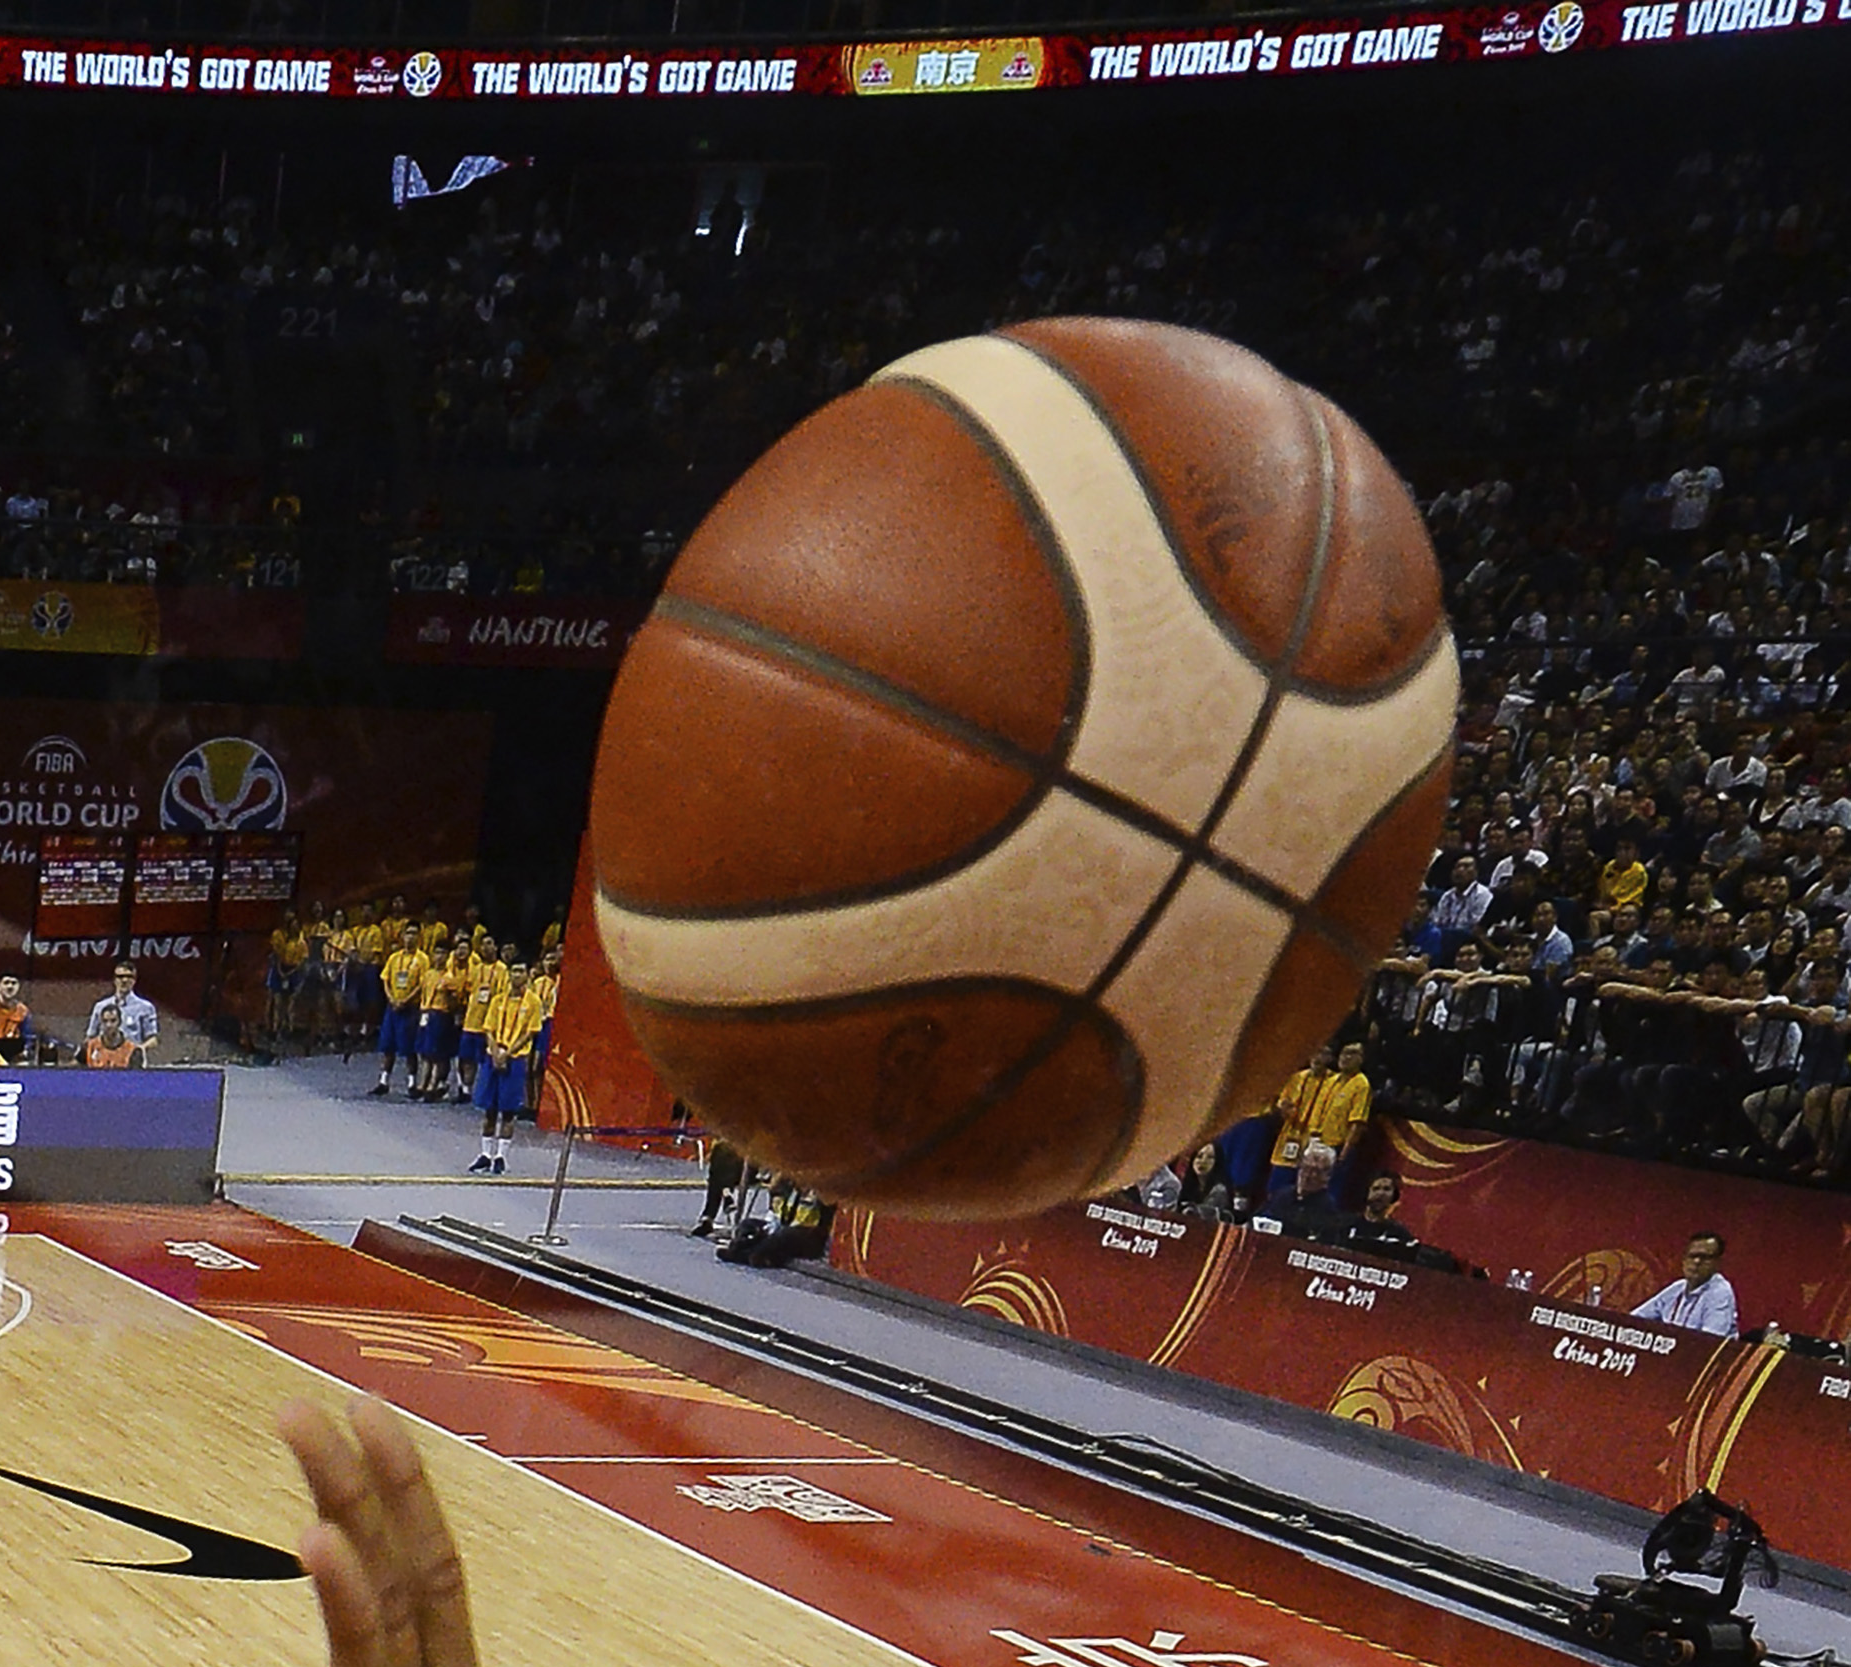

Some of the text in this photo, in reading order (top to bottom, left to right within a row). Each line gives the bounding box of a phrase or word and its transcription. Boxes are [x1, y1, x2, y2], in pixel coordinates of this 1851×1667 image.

[1623, 3, 1674, 41] THE
[915, 52, 976, 86] 南京
[1089, 24, 1443, 80] THE WORLD'S GOT GAME
[22, 49, 332, 92] THE WORLD'S GOT GAME
[472, 55, 797, 95] THE WORLD'S GOT GAME
[259, 558, 301, 588] 121
[406, 564, 448, 591] 122
[34, 751, 75, 775] FIBA
[79, 802, 141, 830] CUP
[1305, 1276, 1377, 1311] China 2019
[1530, 1305, 1677, 1355] FIBA BASKETBALL WORLD CUP
[1552, 1336, 1638, 1378] China 2019
